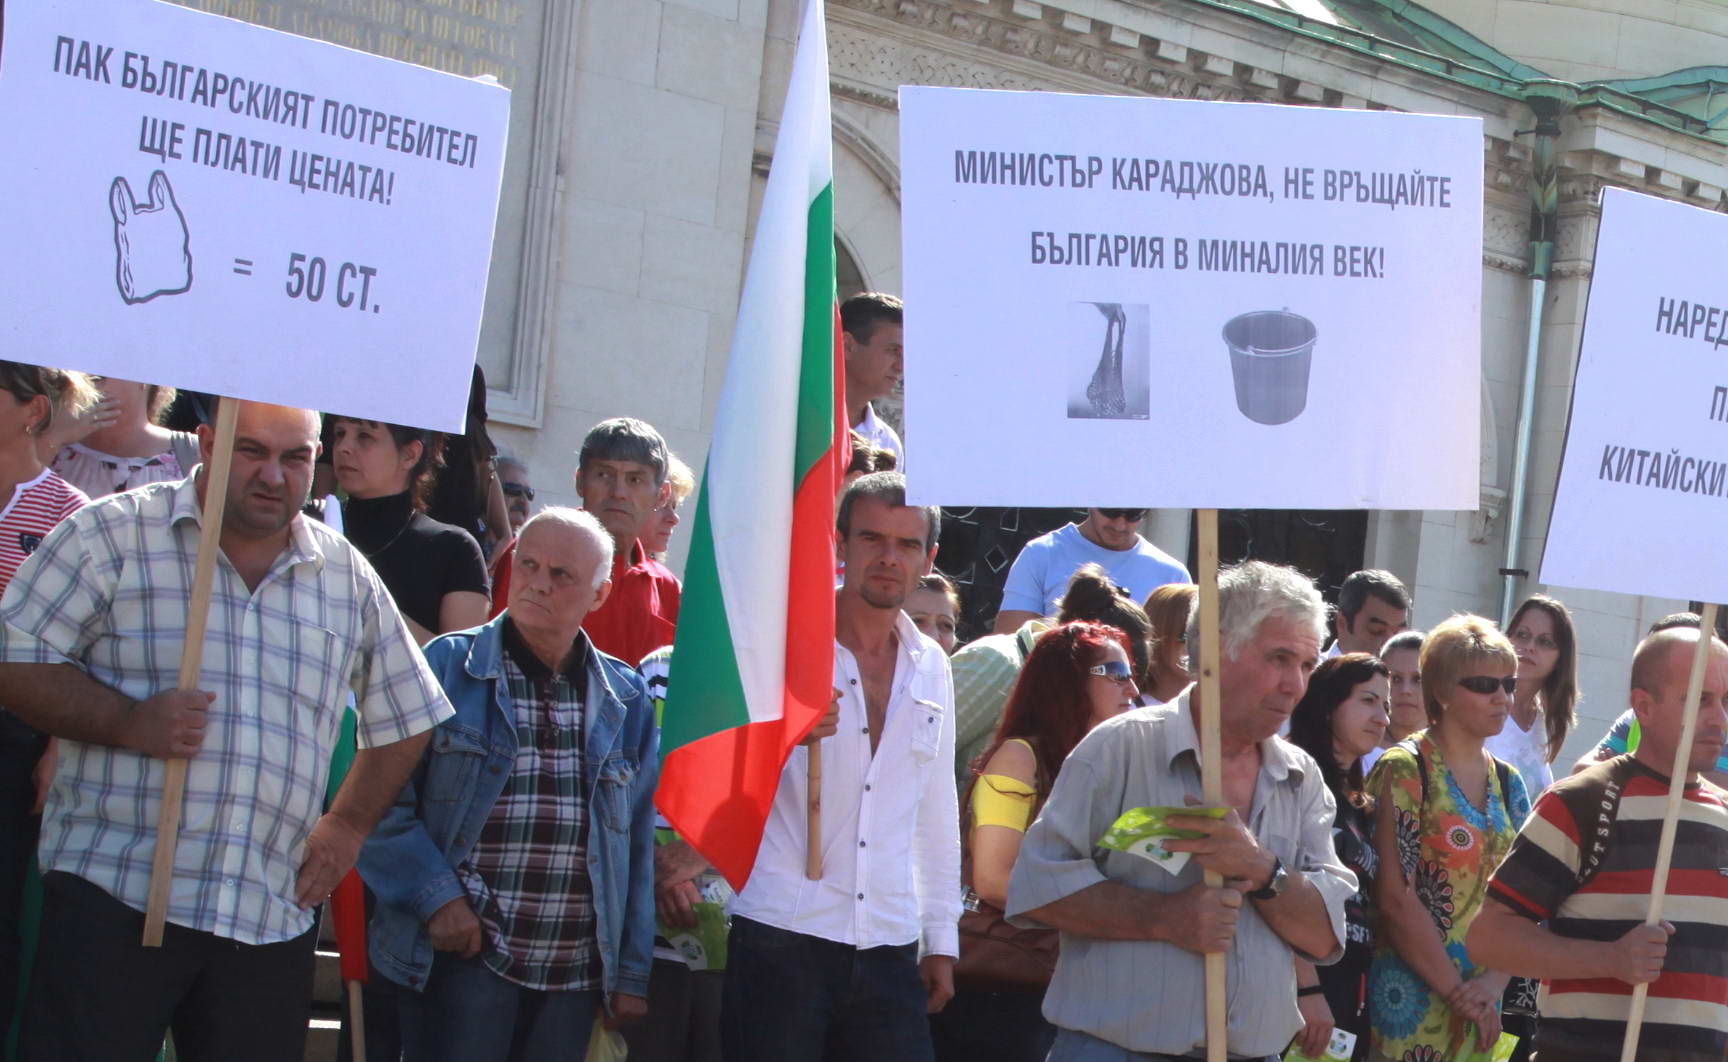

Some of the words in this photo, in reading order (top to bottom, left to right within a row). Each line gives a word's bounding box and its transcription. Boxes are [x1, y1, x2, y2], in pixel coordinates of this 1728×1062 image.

[53, 35, 114, 85] ПАК
[121, 50, 315, 132] БЪЛГАРСКИЯТ
[320, 98, 478, 168] ПОТРЕБИТЕЛ
[138, 115, 186, 164] ЩЕ
[192, 127, 282, 181] ПЛАТИ
[288, 144, 395, 206] ЦЕНАТА!
[954, 149, 1103, 189] МИНИСТЪР
[1112, 157, 1274, 204] КАРАДЖОВА,
[1284, 166, 1315, 200] НЕ
[1323, 168, 1452, 212] ВРЪЩАЙТЕ
[285, 252, 327, 303] 50
[336, 261, 380, 314] СТ.
[1031, 231, 1164, 269] БЪЛГАРИЯ
[1174, 237, 1189, 270] В
[1198, 238, 1324, 276] МИНАЛИЯ
[1333, 244, 1385, 279] ВЕК!
